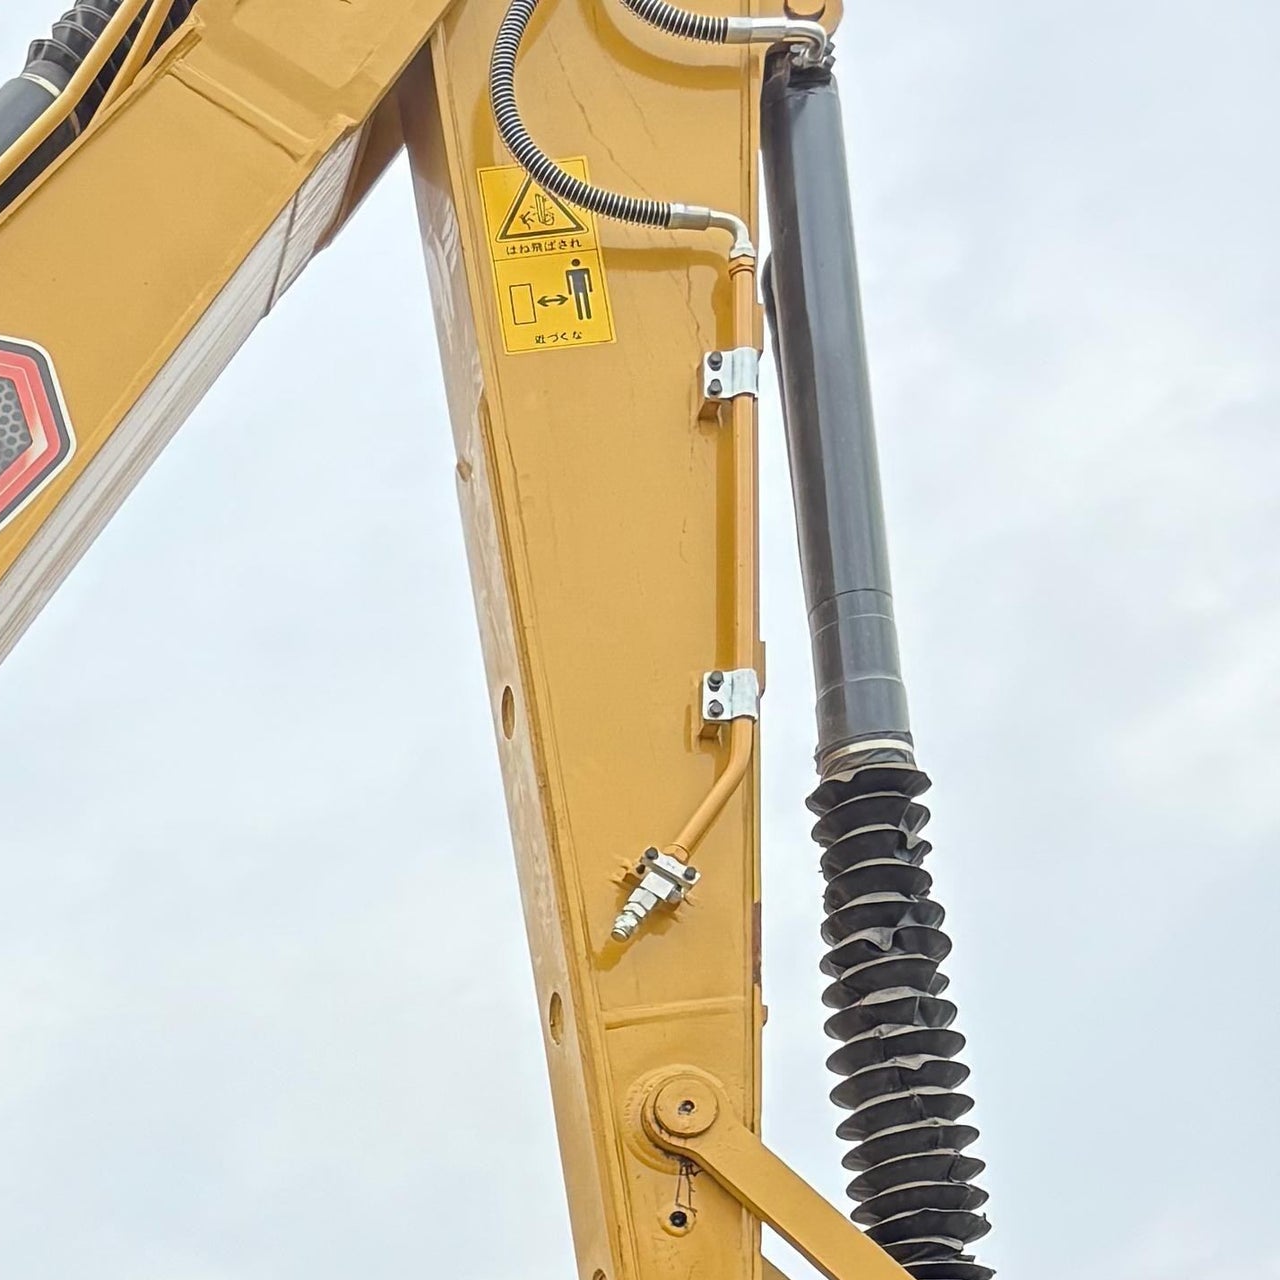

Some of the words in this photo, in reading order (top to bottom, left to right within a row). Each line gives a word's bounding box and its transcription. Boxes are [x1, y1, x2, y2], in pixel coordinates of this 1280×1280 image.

[506, 239, 582, 256] はね飛ばされ
[535, 331, 583, 345] 近づくな
